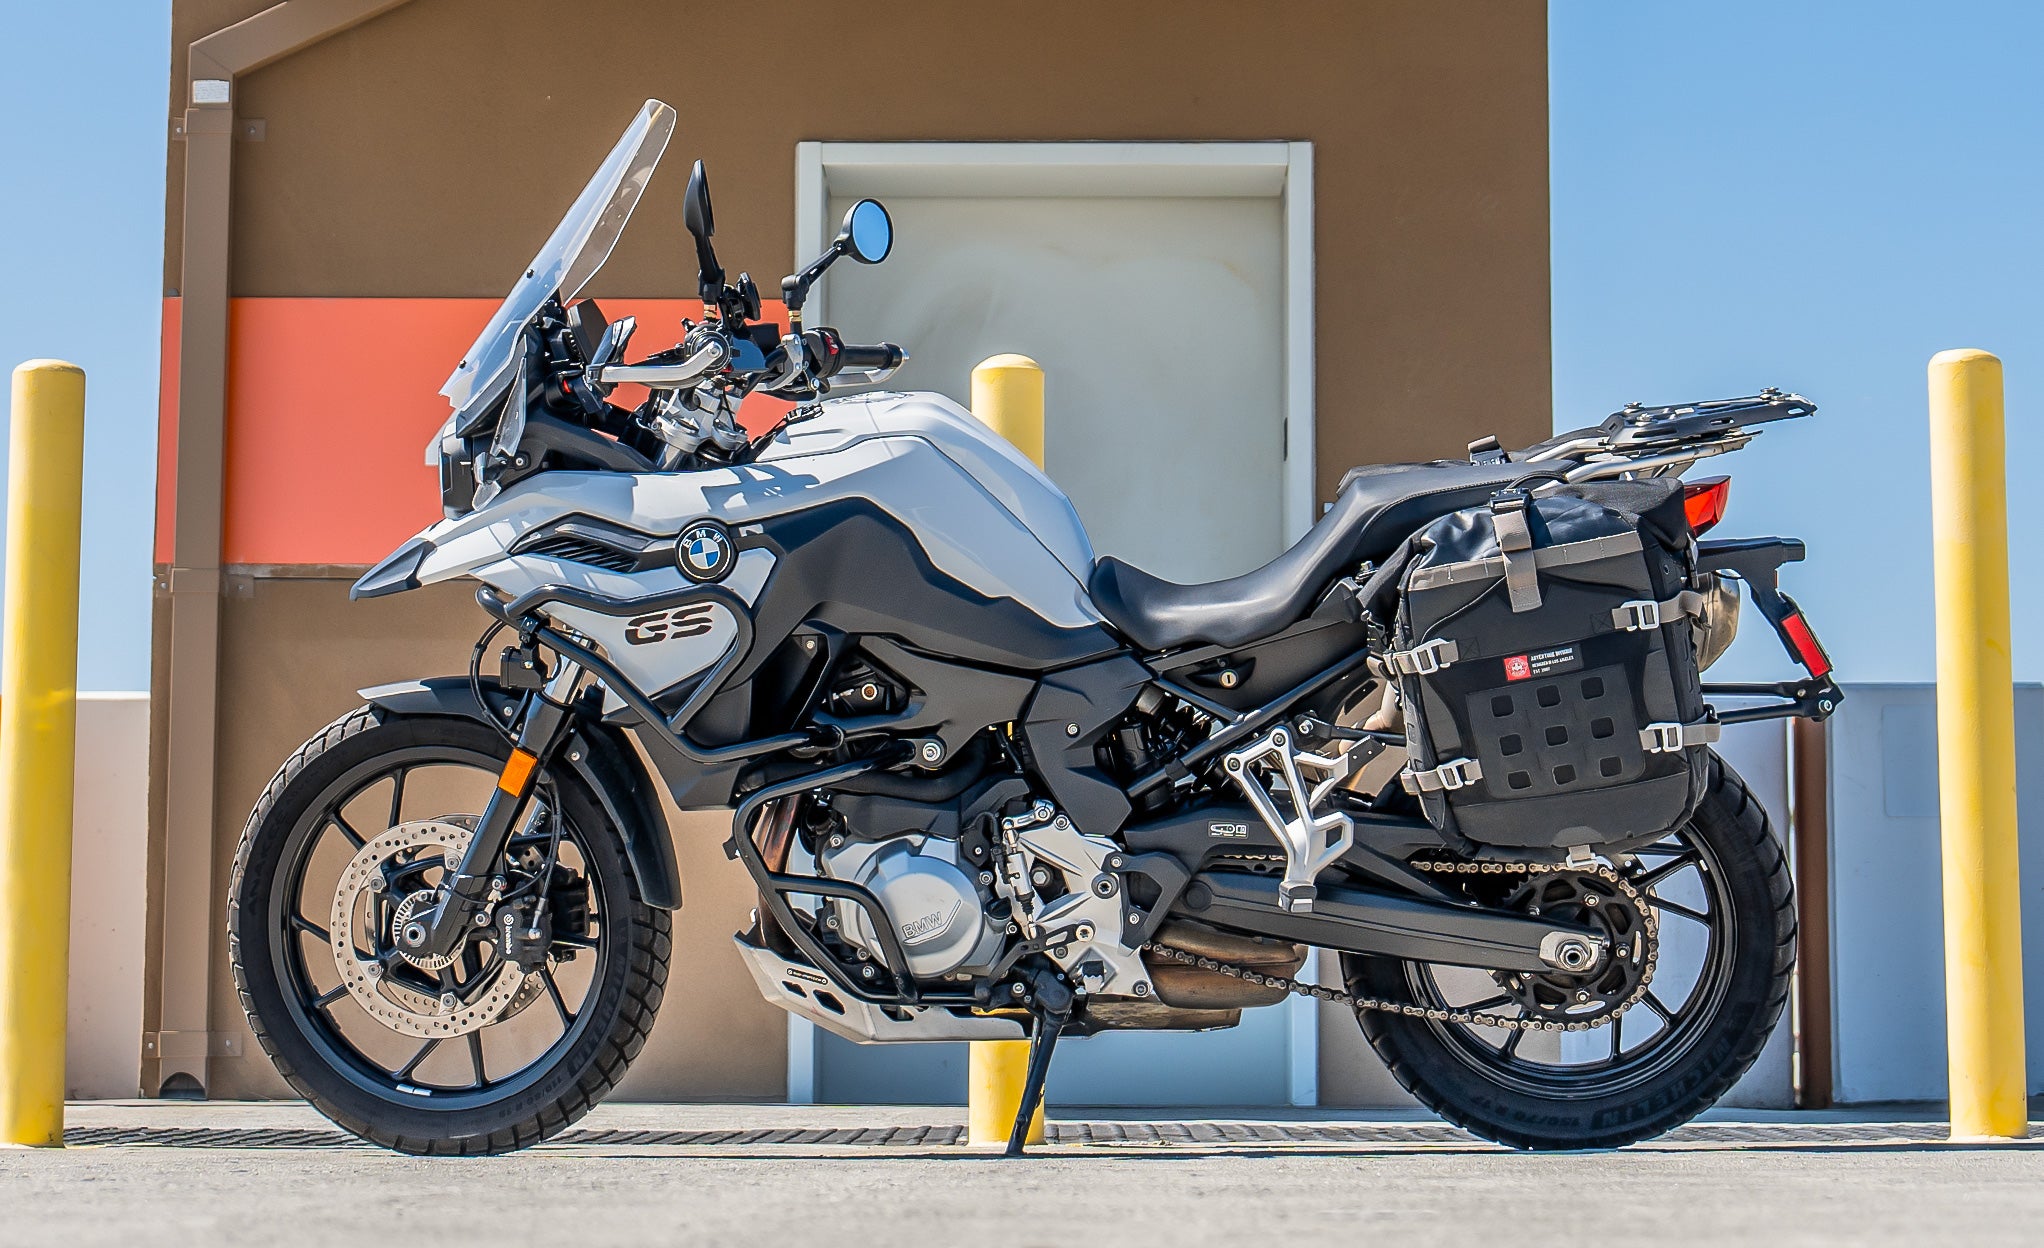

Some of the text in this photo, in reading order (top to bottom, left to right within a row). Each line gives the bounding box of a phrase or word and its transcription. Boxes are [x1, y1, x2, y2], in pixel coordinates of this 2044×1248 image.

[682, 529, 723, 548] BMW
[625, 604, 714, 646] GS
[902, 911, 943, 939] BMW
[573, 952, 627, 1069] MICHELIN
[1602, 1037, 1731, 1127] MICHELIN
